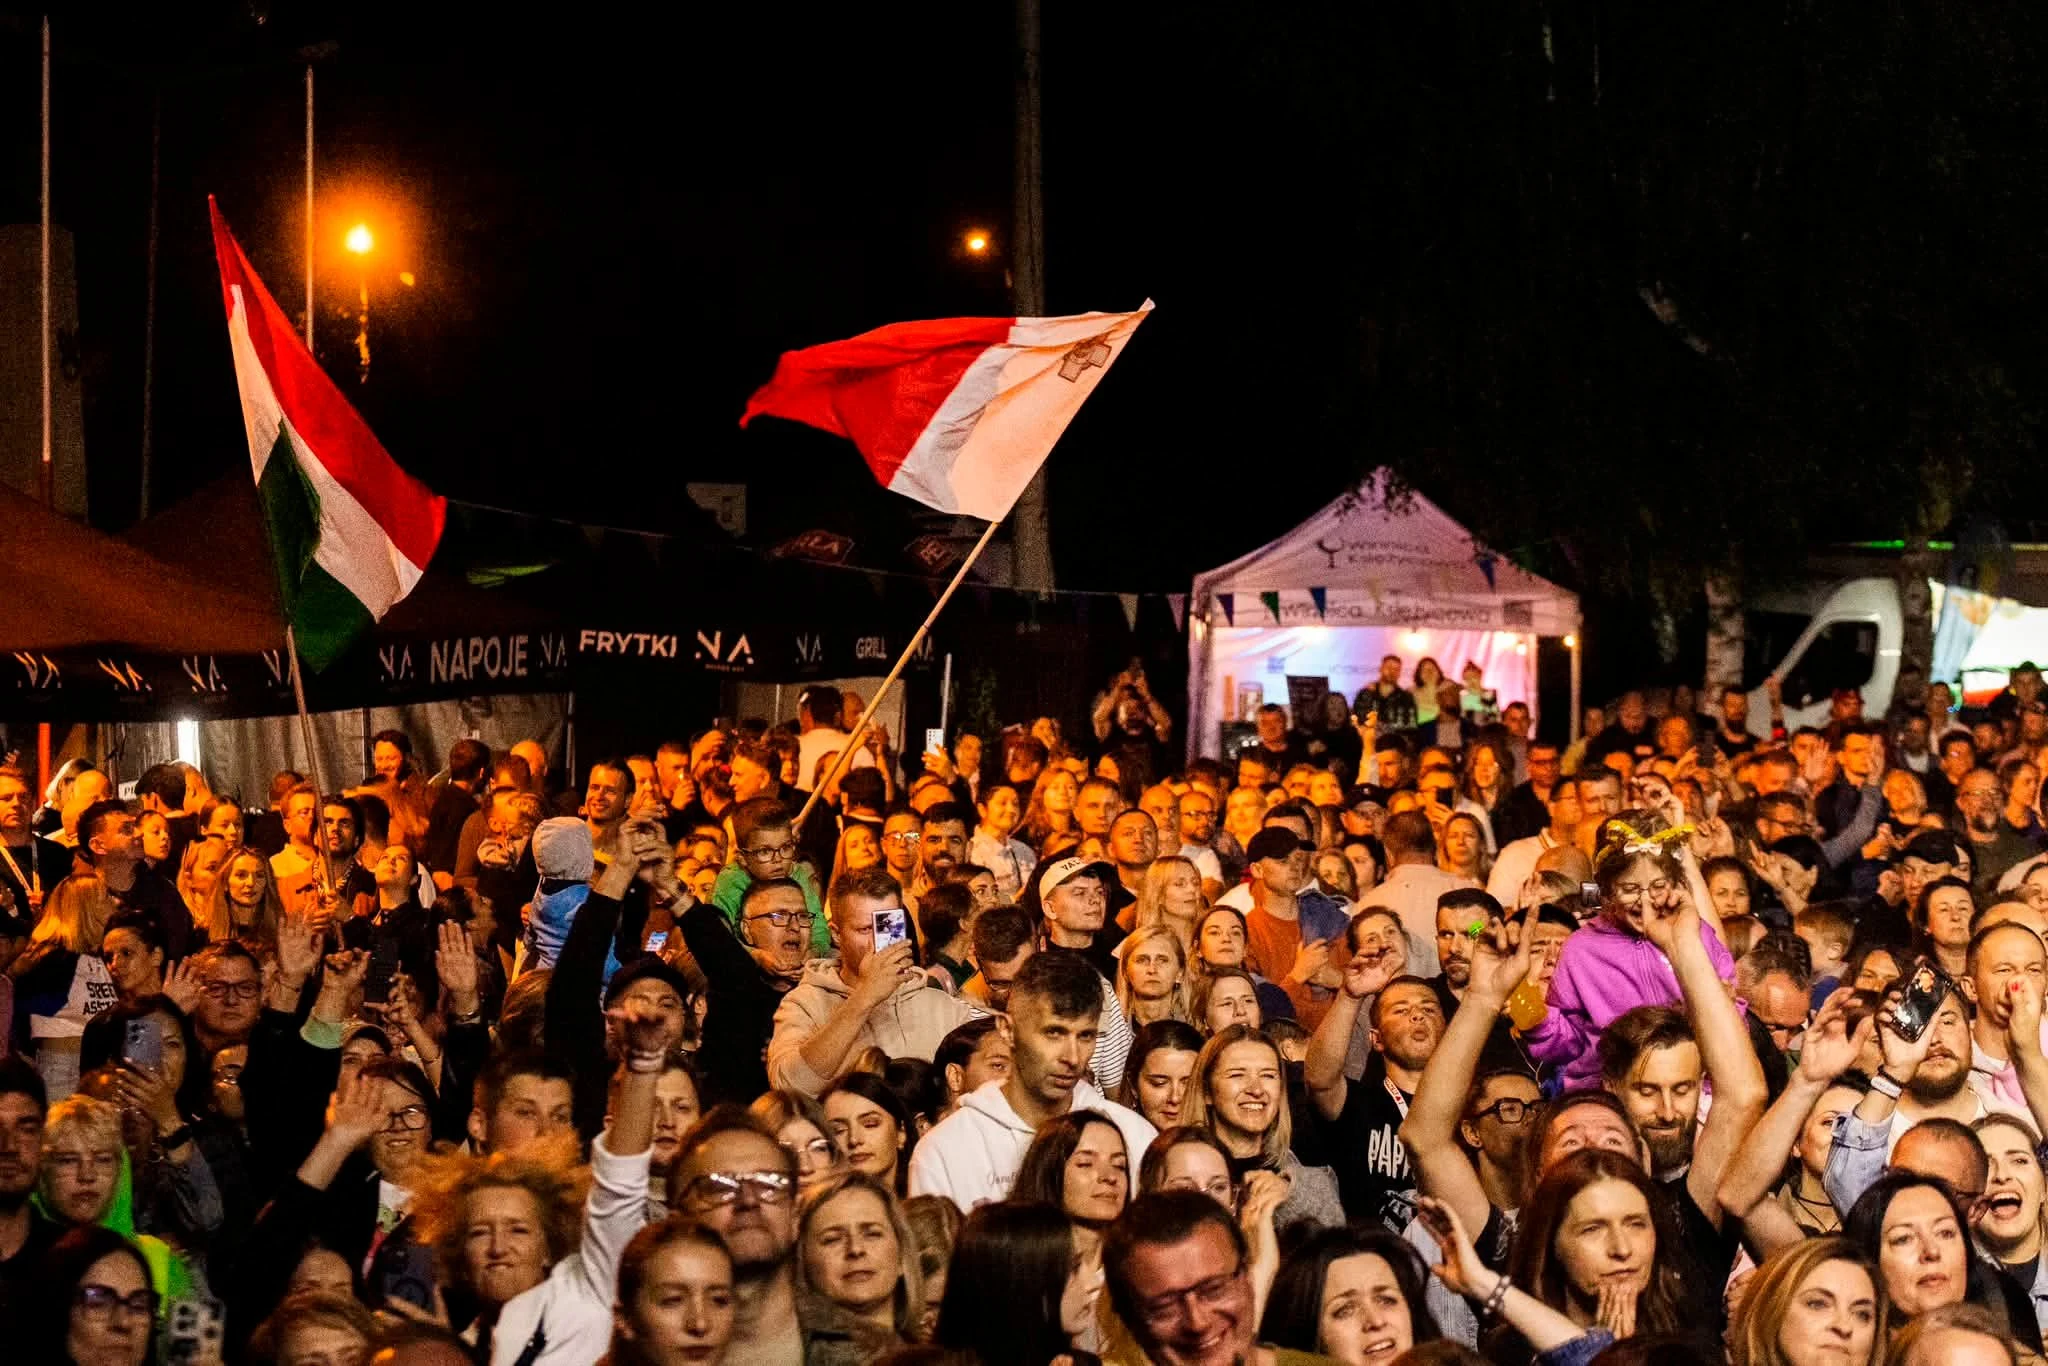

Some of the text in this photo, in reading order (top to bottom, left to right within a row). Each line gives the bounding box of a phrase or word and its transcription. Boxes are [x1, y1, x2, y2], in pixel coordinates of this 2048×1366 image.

[578, 629, 679, 658] FRYTKI
[855, 636, 888, 660] GRILL
[429, 634, 529, 684] NAPOJE
